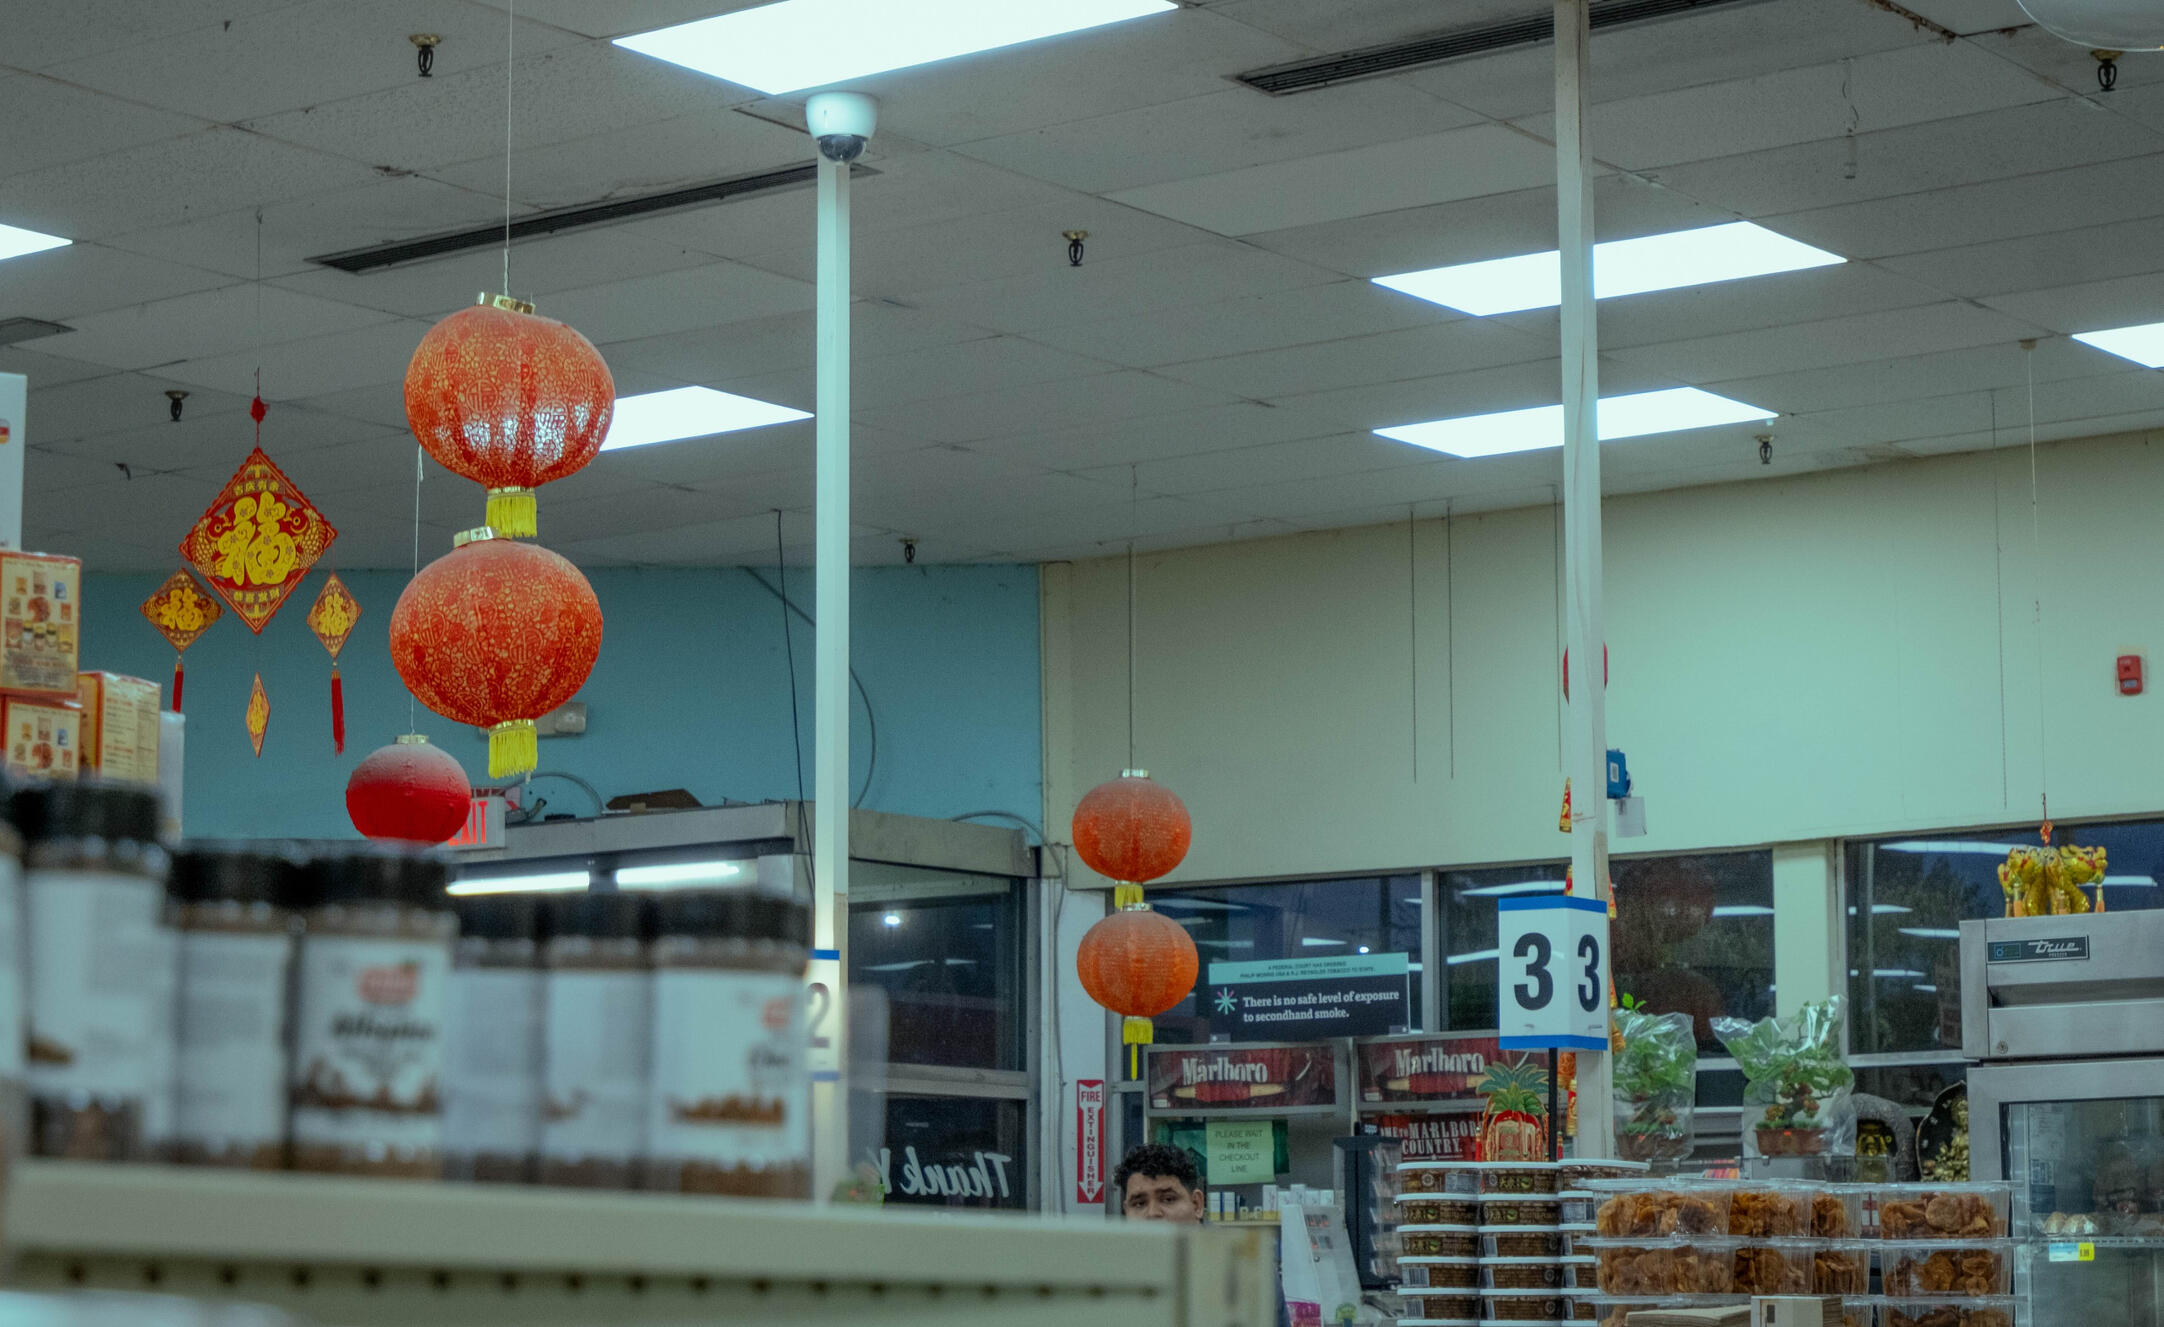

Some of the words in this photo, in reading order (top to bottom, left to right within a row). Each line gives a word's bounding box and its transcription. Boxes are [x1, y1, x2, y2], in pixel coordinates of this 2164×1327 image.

[217, 491, 296, 586] 福
[160, 587, 204, 630] 福
[319, 592, 348, 637] 福
[1513, 932, 1554, 1011] 3
[1577, 934, 1600, 1012] 3
[1242, 996, 1272, 1007] There
[1273, 995, 1282, 1005] is
[1283, 996, 1296, 1005] no
[1297, 993, 1317, 1004] safe
[1318, 992, 1342, 1003] level
[1343, 991, 1355, 1002] of
[1355, 991, 1400, 1003] exposure
[807, 982, 831, 1050] 2
[1243, 1012, 1254, 1022] to
[1255, 1008, 1314, 1021] secondhand
[1314, 1008, 1350, 1019] smoke.
[1181, 1056, 1269, 1086] Marlboro
[1394, 1046, 1485, 1077] Marlboro
[1081, 1090, 1101, 1102] FIRE
[1244, 1129, 1263, 1137] WAIT
[1401, 1137, 1463, 1155] COUNTRY.
[1087, 1106, 1095, 1194] EXTINGUISHER
[1219, 1153, 1260, 1161] CHECKOUT
[1231, 1165, 1247, 1173] LINE
